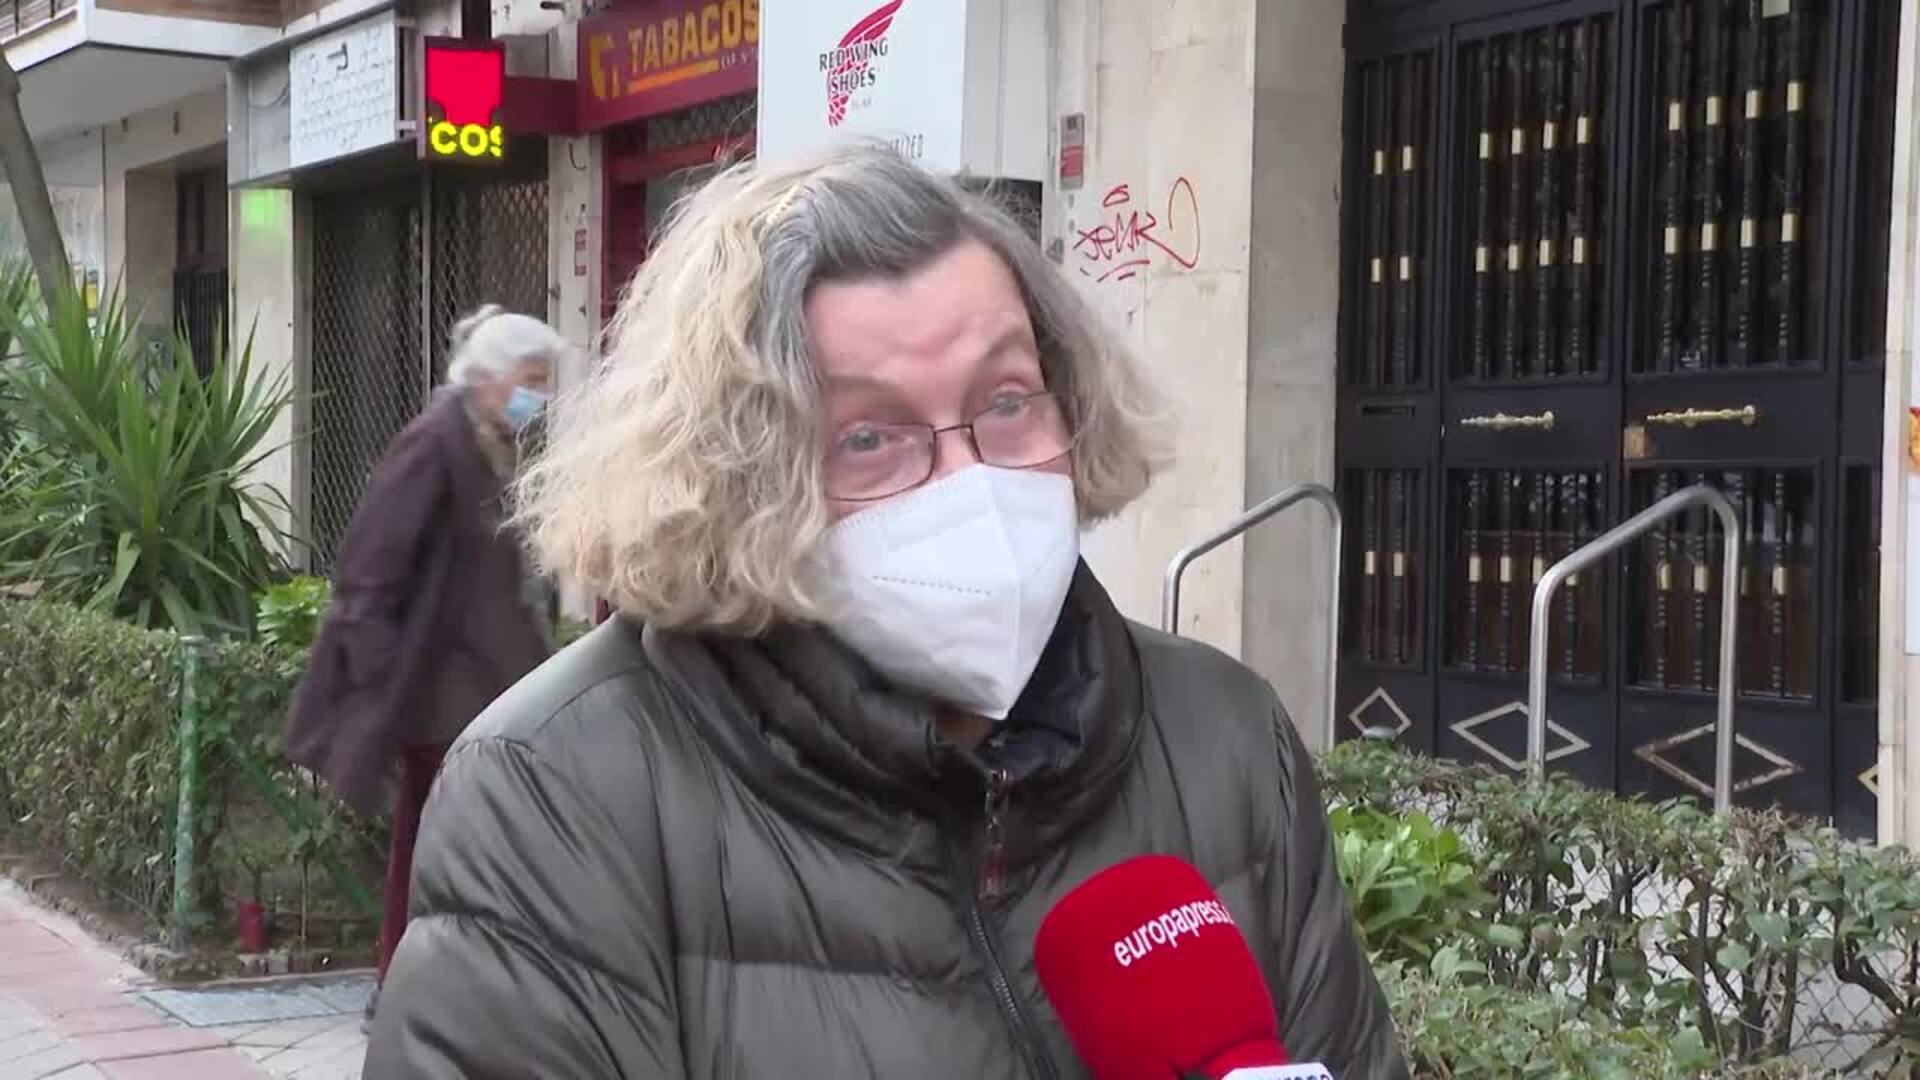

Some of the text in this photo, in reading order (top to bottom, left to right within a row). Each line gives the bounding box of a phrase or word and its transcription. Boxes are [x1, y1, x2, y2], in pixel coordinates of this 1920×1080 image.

[628, 0, 759, 75] TABACOS
[819, 37, 889, 72] RED WING
[831, 67, 876, 94] SHOES
